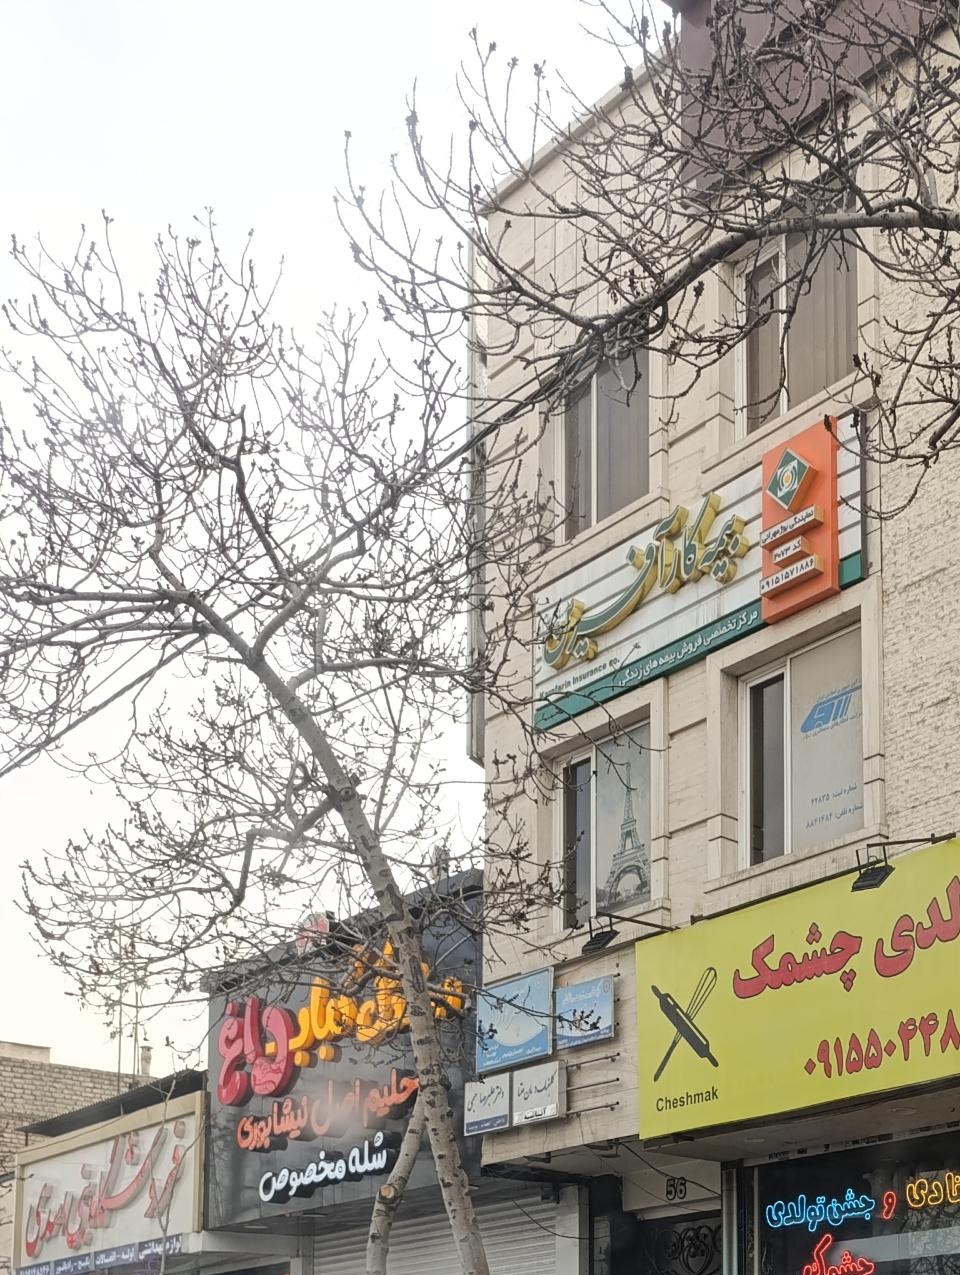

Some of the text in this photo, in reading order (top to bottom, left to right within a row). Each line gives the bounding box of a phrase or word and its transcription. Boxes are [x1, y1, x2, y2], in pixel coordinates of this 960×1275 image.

[792, 539, 801, 551] کد
[543, 490, 750, 670] بیمه کارآفرین
[703, 619, 737, 646] تخصصی
[736, 608, 758, 630] مرکز
[658, 650, 677, 668] بیمه
[677, 634, 702, 660] فروش
[572, 663, 607, 685] Insurance
[618, 664, 644, 688] زندگی
[732, 921, 863, 1000] چشمک
[363, 1067, 420, 1129] حلیم
[655, 1085, 719, 1113] Cheshmak
[236, 1094, 308, 1151] نیشابوری
[258, 1131, 388, 1202] شله مخصوص
[665, 1176, 687, 1200] 56
[765, 1194, 826, 1232] تولدی
[826, 1187, 876, 1226] جشن
[882, 1190, 897, 1220] و
